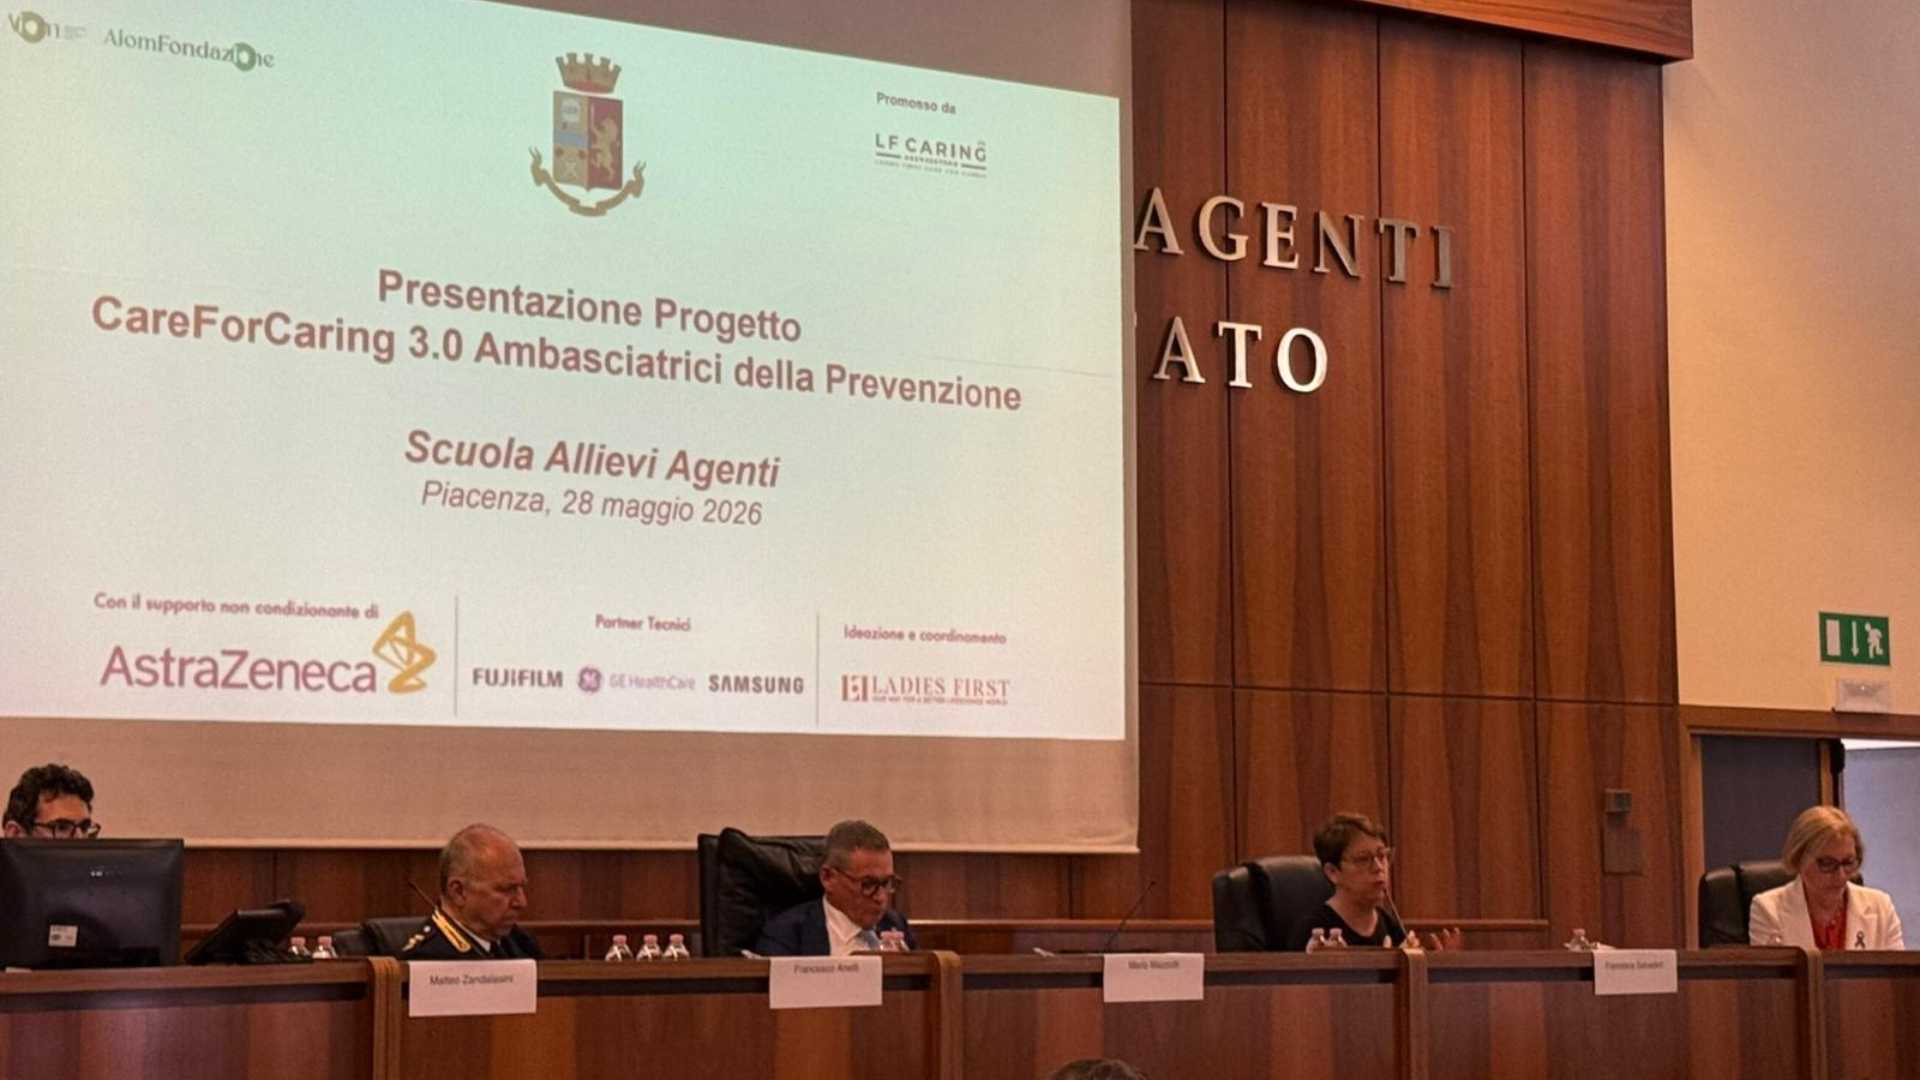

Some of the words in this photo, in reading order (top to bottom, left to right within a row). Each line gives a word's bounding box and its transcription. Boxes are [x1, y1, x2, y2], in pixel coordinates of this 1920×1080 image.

[876, 91, 938, 112] Promosso
[941, 102, 956, 114] da
[875, 133, 899, 150] LF
[905, 137, 987, 162] CARING
[1133, 187, 1455, 289] AGENTI
[378, 268, 642, 326] Presentazione
[655, 297, 802, 344] Progetto
[92, 295, 395, 364] CareForCaring
[409, 325, 463, 361] 3.0
[474, 331, 722, 385] Ambasciatrici
[734, 356, 815, 393] della
[826, 364, 1022, 411] Prevenzione
[1135, 312, 1328, 393] ATO
[405, 429, 534, 470] Scuola
[544, 440, 659, 479] Allievi
[666, 449, 781, 491] Agenti
[422, 480, 550, 516] Piacenza,
[562, 490, 594, 515] 28
[601, 496, 694, 526] maggio
[703, 498, 763, 526] 2026
[94, 592, 127, 609] Con
[132, 593, 141, 610] il
[146, 598, 216, 616] supporto
[220, 602, 250, 614] non
[255, 601, 360, 619] condizionante
[364, 604, 379, 619] di
[595, 614, 643, 630] Partner
[648, 615, 691, 632] Tecnici
[844, 625, 905, 641] Ideazione
[908, 632, 916, 642] e
[920, 627, 1007, 645] coordinamento
[100, 645, 377, 693] AstraZeneca
[472, 667, 563, 688] FUJIFILM
[709, 674, 804, 694] SAMSUNG
[872, 675, 946, 695] LADIES
[954, 677, 1010, 697] FIRST
